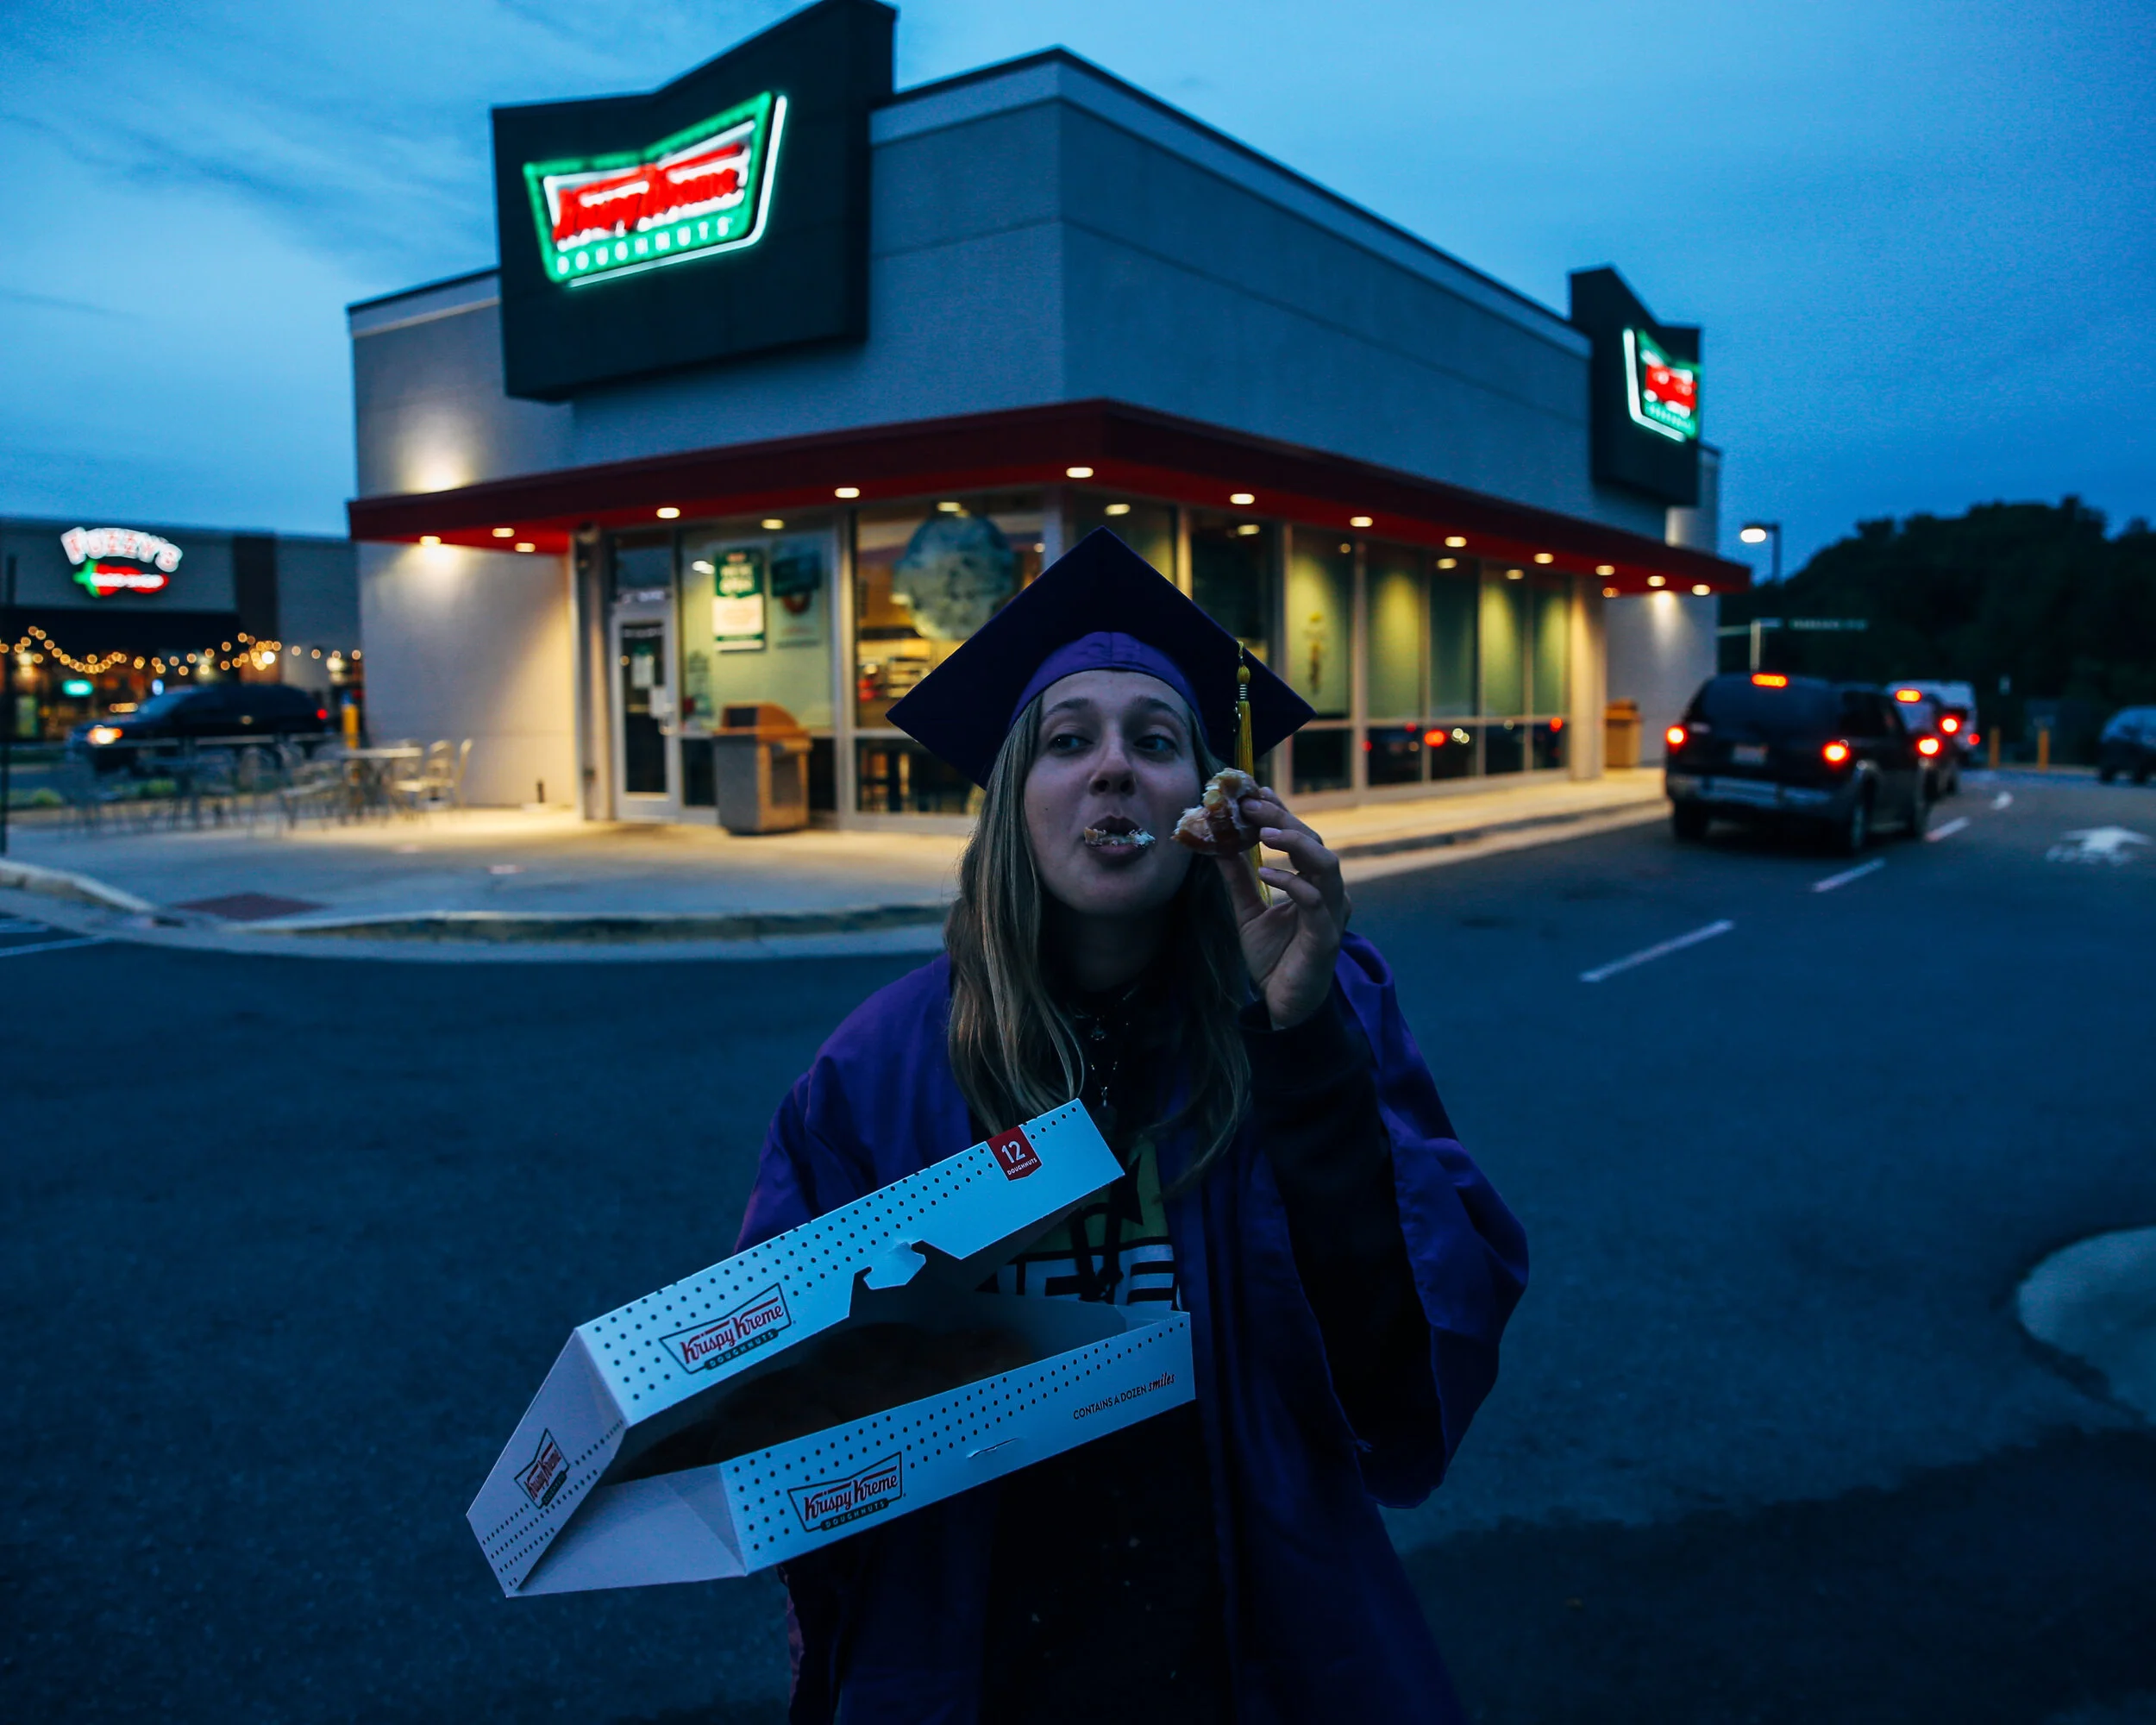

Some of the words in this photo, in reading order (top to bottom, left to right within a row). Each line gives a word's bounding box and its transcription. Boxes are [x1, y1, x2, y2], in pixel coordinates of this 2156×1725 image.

[1001, 1140, 1026, 1164] 12
[1006, 1157, 1037, 1176] DOUGHNUTS
[680, 1320, 736, 1364] Krispy
[731, 1296, 785, 1339] Kreme
[709, 1331, 775, 1367] DOUGHNUTS
[1073, 1397, 1113, 1420] CONTAINS
[1113, 1395, 1120, 1406] A
[1120, 1384, 1147, 1402] DOZEN
[1148, 1371, 1175, 1392] smiles
[804, 1481, 853, 1521] Krispy
[853, 1465, 899, 1504] Kreme
[824, 1502, 886, 1528] DOUGHNUTS
